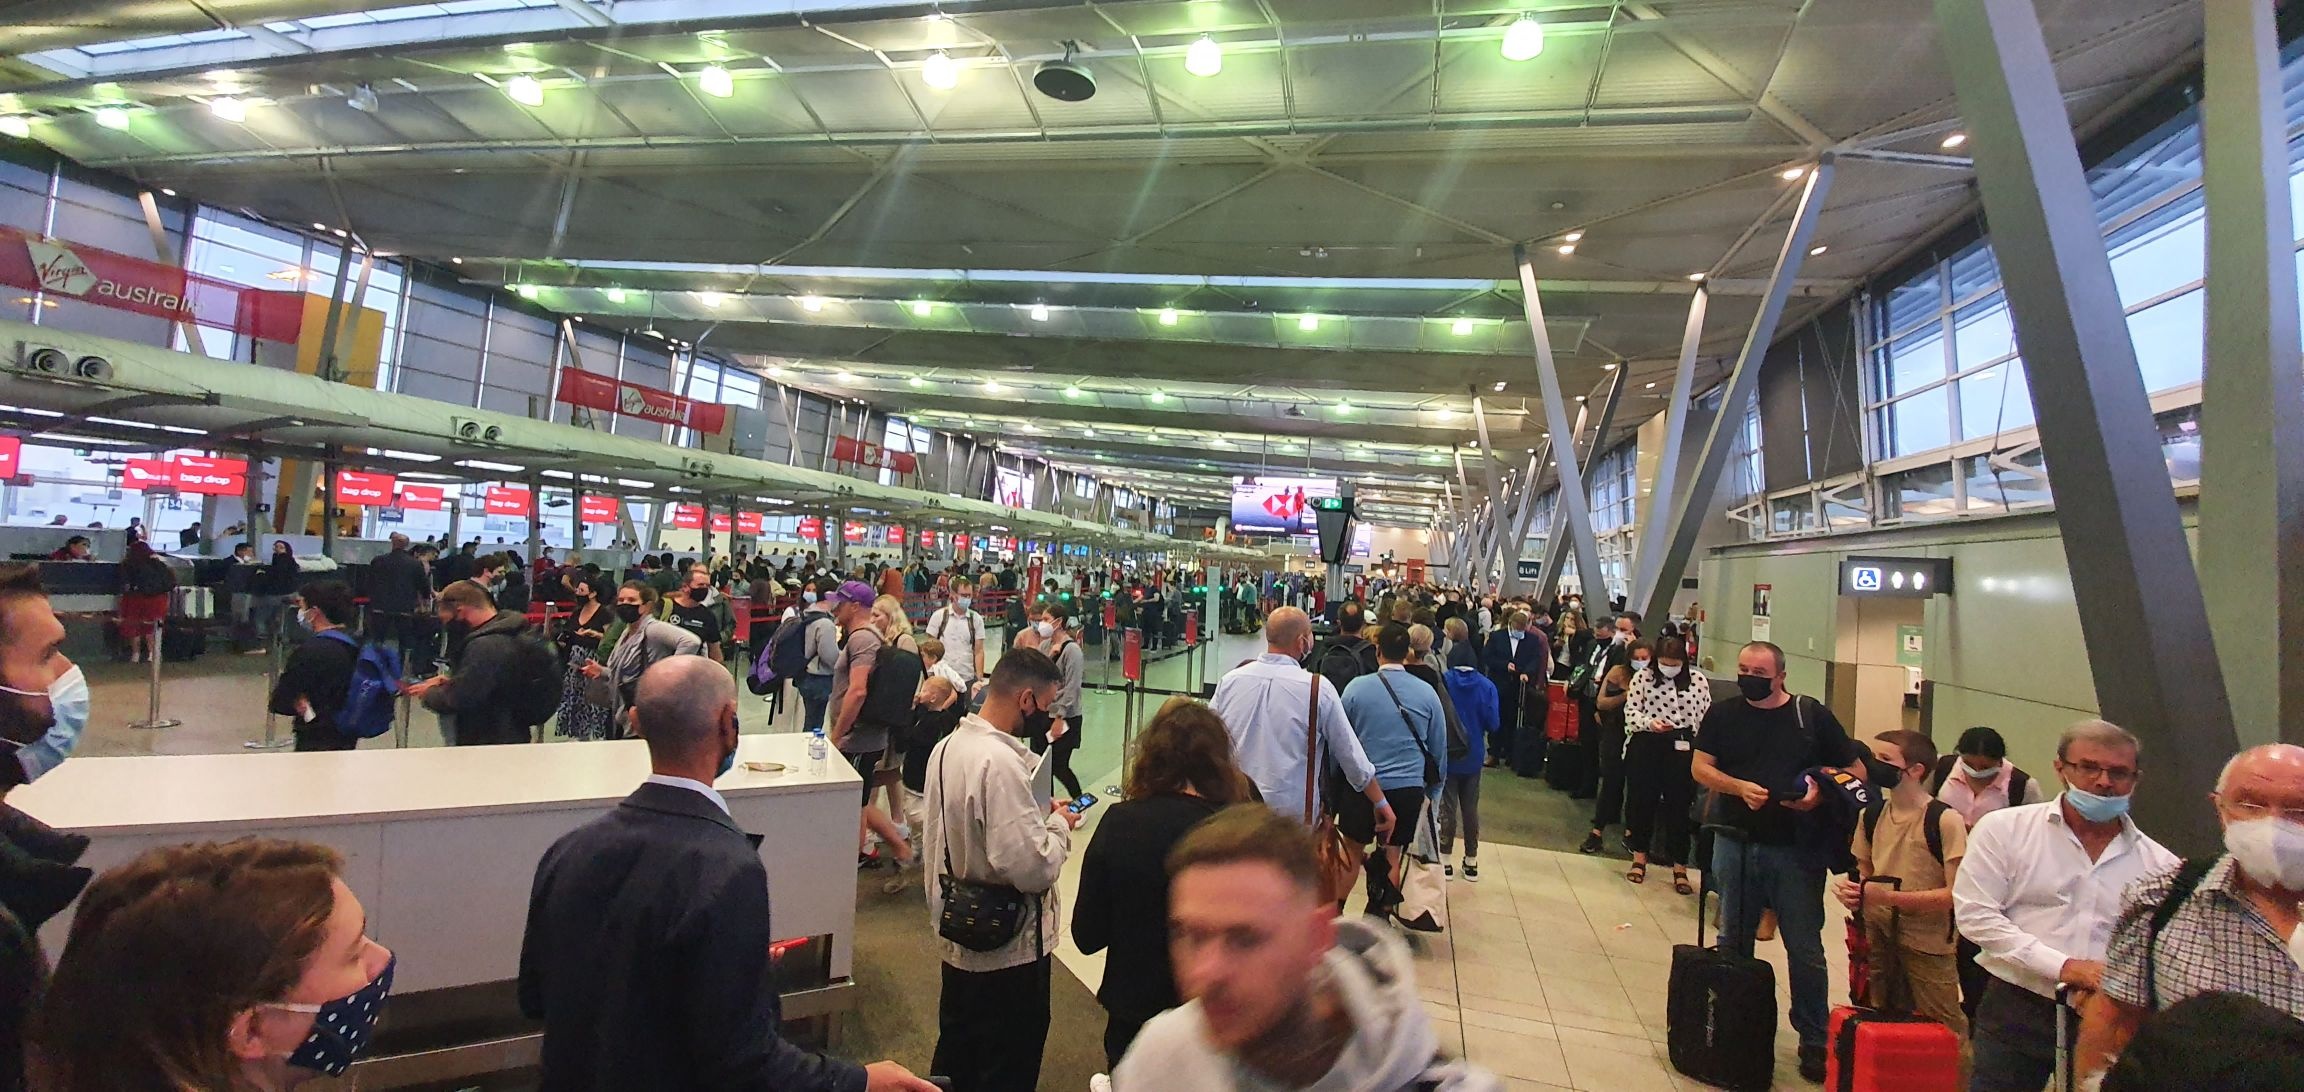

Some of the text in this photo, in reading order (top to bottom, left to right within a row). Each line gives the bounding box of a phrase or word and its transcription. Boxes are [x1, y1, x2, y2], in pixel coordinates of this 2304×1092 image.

[179, 472, 202, 484] bag
[203, 474, 230, 485] drop
[341, 486, 382, 498] bag drop
[1525, 567, 1537, 575] Lift
